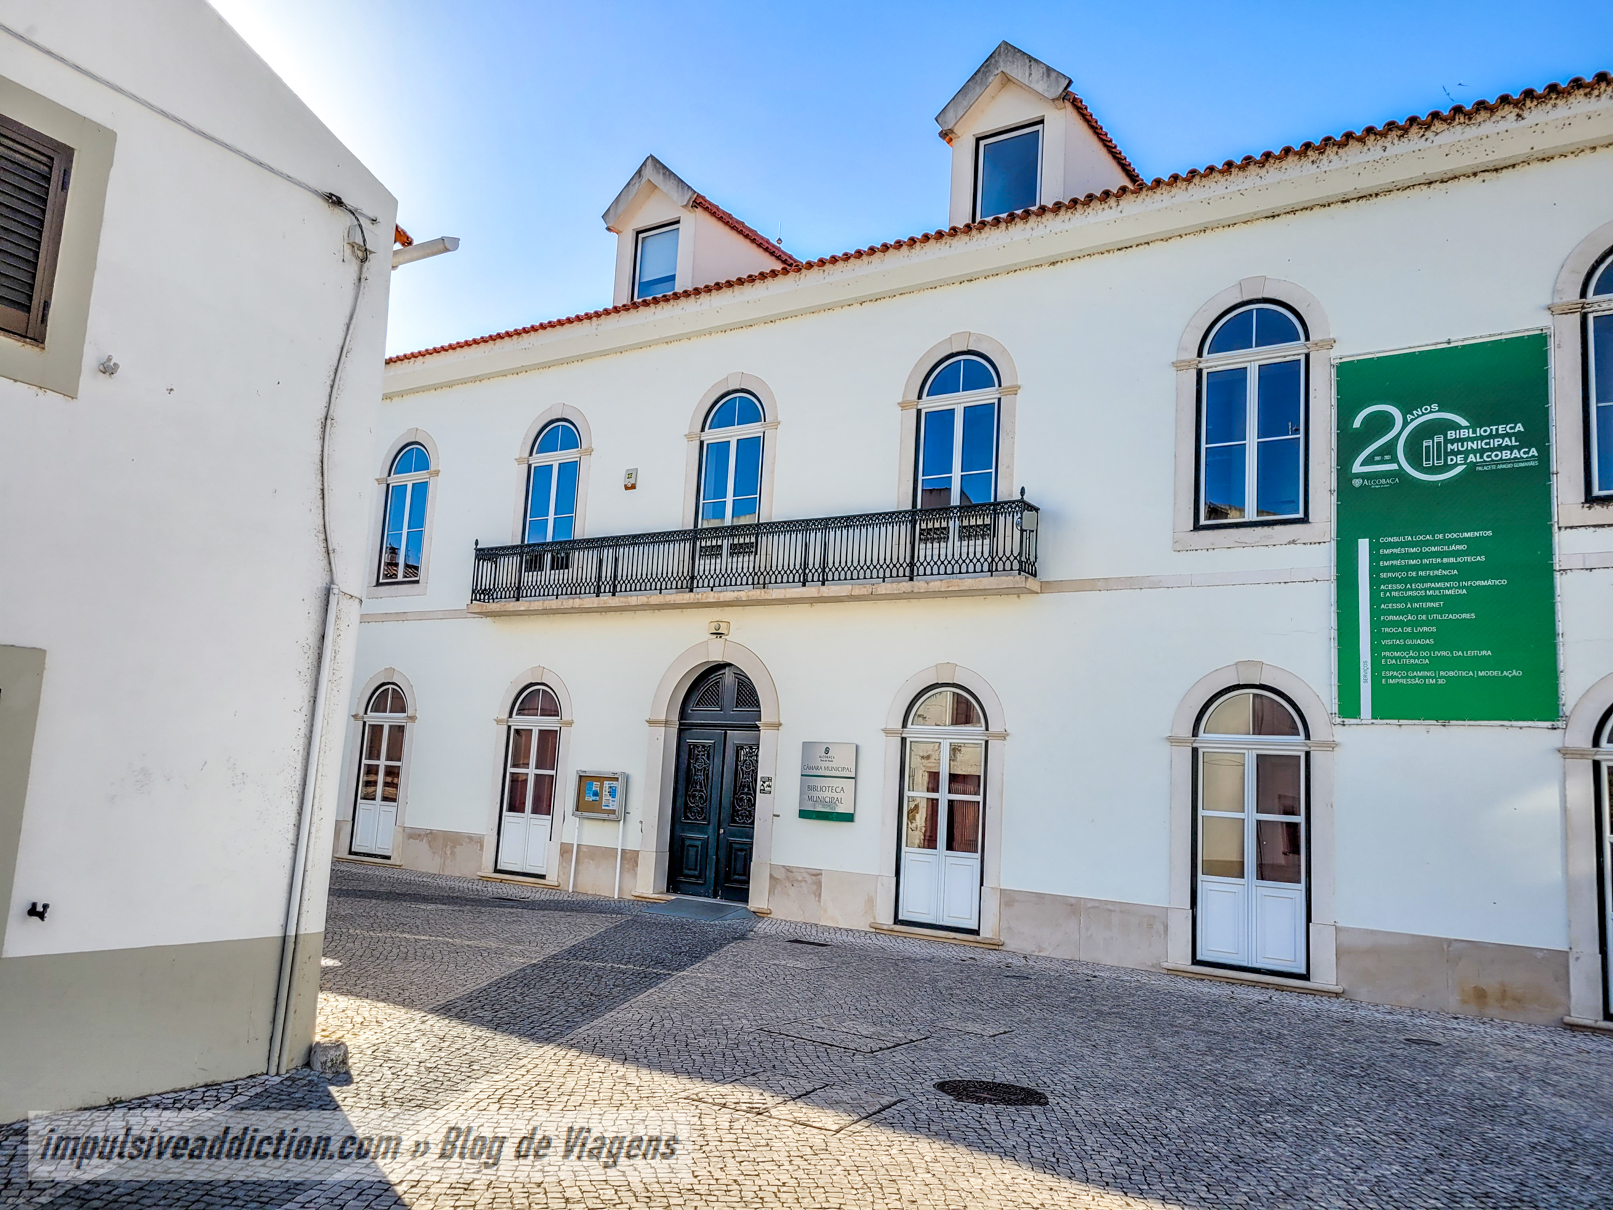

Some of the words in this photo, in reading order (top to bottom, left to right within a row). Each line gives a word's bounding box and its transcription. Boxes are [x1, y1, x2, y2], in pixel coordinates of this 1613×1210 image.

[1406, 404, 1439, 422] ANOS
[1447, 423, 1524, 439] BIBLIOTECA
[1447, 436, 1519, 452] MUNICIPAL
[1447, 455, 1465, 465] DE
[1466, 448, 1538, 463] ALCOBAÇA
[1362, 478, 1399, 486] ALCOBAÇA
[1445, 530, 1492, 539] DOCUMENTOS
[1422, 544, 1467, 552] DOMICILIÁRIO
[1422, 556, 1485, 564] INTER-BIBLIOTECAS
[1478, 669, 1522, 677] MODELAÇÃO
[807, 785, 845, 794] BIBLIOTECA
[807, 795, 844, 804] MUNICIPAL
